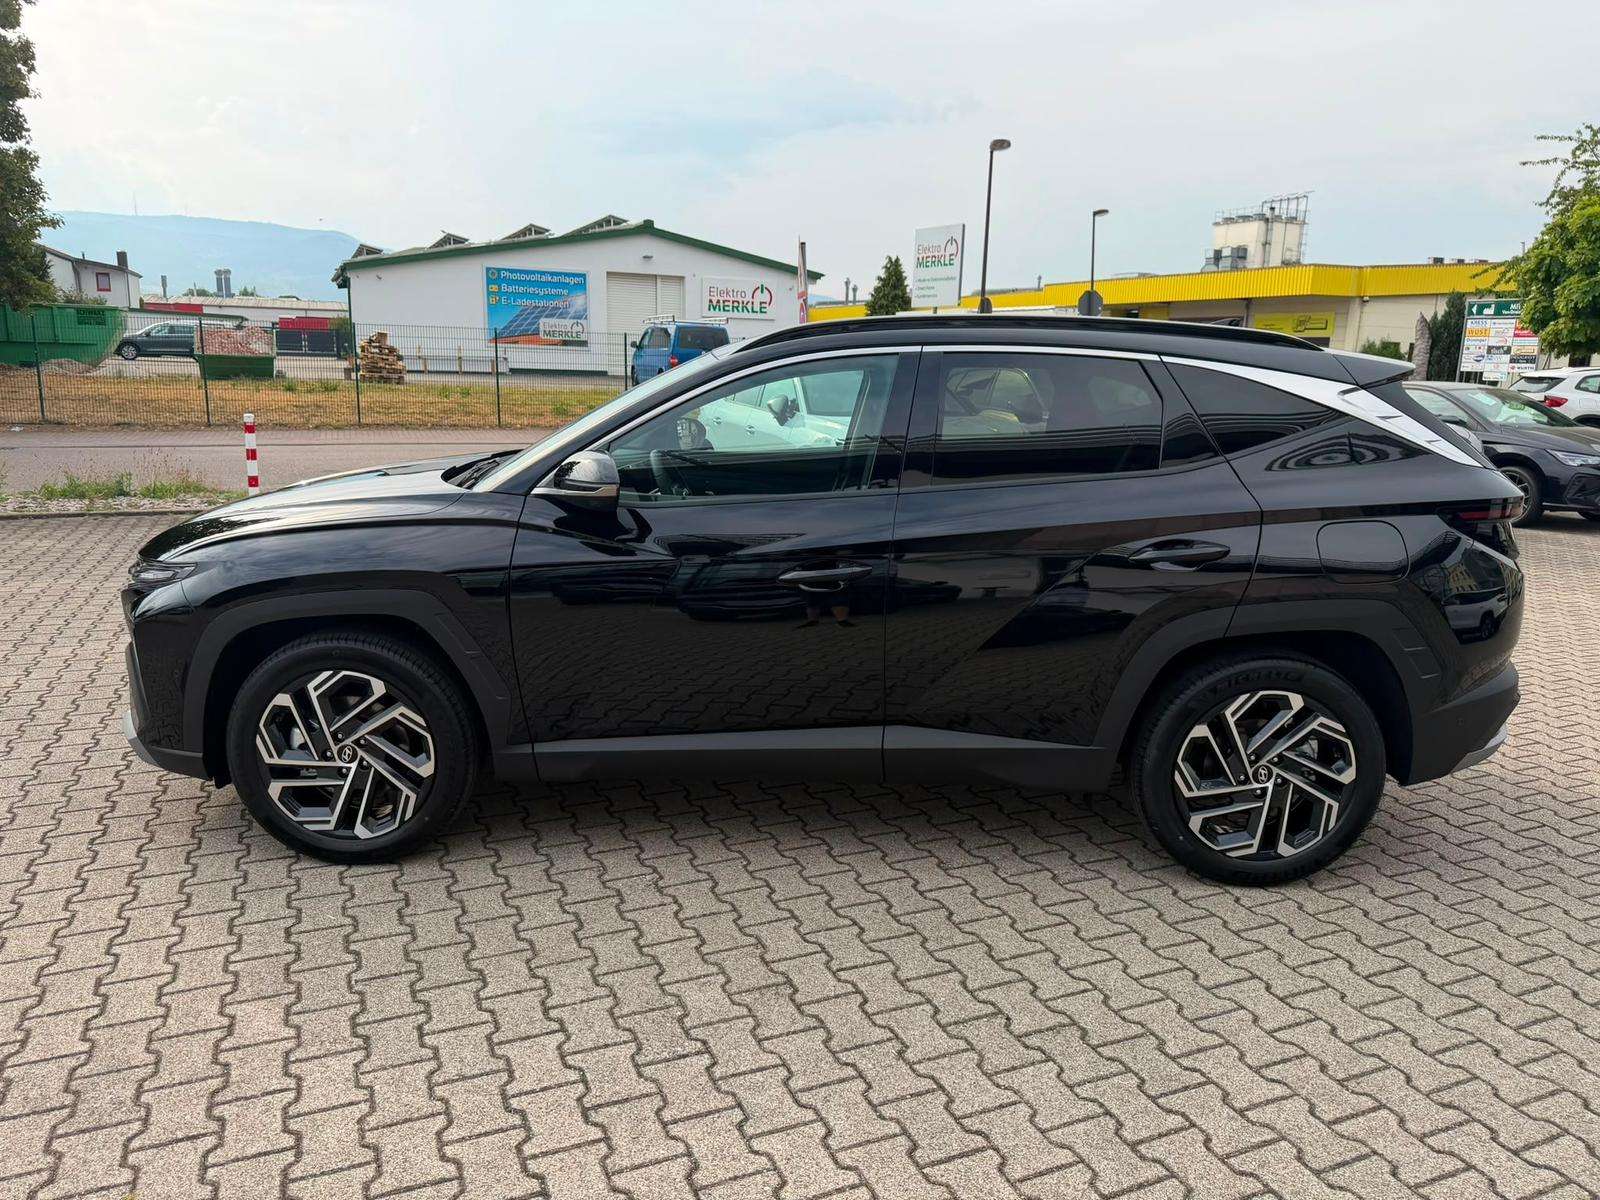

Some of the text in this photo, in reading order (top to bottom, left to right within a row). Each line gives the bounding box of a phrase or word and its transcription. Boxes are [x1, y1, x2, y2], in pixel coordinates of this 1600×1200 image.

[917, 243, 942, 254] Elektro
[916, 253, 955, 268] MERKLE
[500, 270, 584, 285] Photovoltaikanlagen
[501, 283, 569, 296] Batteriesysteme
[708, 286, 747, 299] Elektro
[501, 296, 570, 309] E-Ladestationen
[708, 298, 768, 314] MERKLE
[543, 321, 568, 329] Elektro
[542, 329, 582, 339] MERKLE
